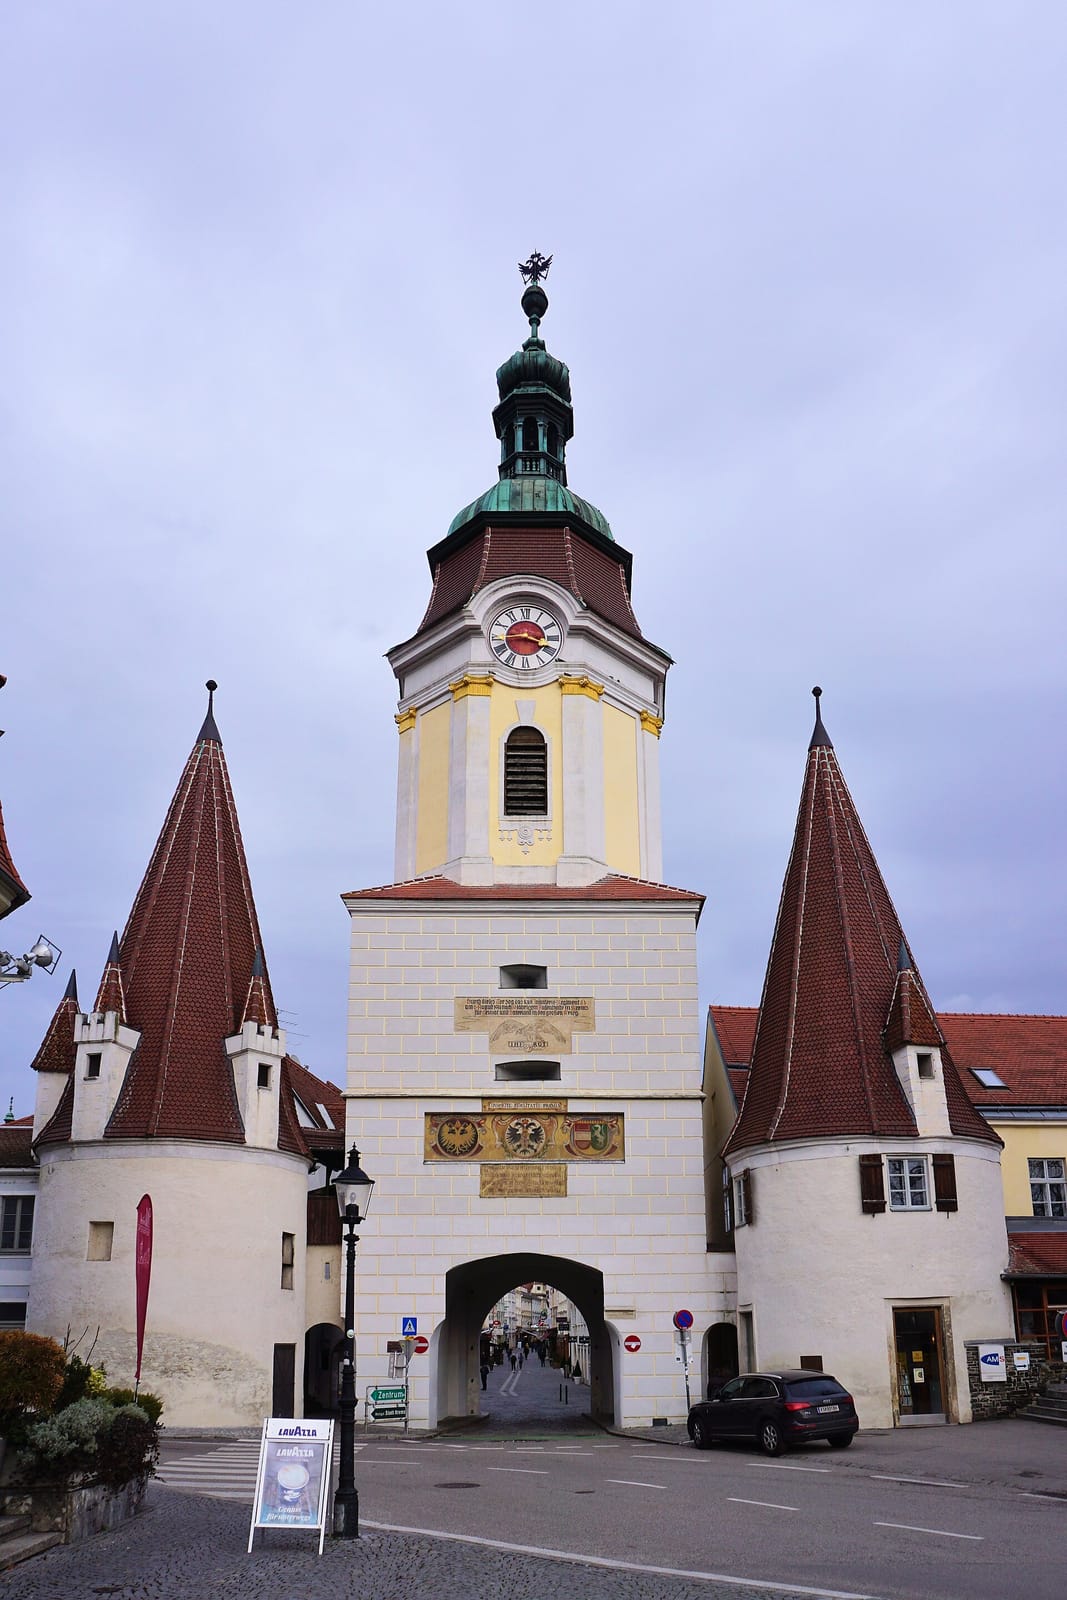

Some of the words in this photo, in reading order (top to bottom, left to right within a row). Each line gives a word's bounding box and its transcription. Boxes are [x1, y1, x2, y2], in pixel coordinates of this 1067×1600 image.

[505, 611, 517, 622] XI
[520, 608, 531, 620] XII
[536, 612, 544, 622] I
[495, 620, 509, 630] X
[543, 621, 556, 630] II
[504, 652, 517, 666] VII
[522, 657, 530, 668] VI
[536, 654, 545, 666] V
[985, 1355, 1005, 1363] AMS
[378, 1391, 404, 1399] Zentrum
[278, 1426, 317, 1437] LAVAZZA
[276, 1446, 315, 1457] LAVAZZA
